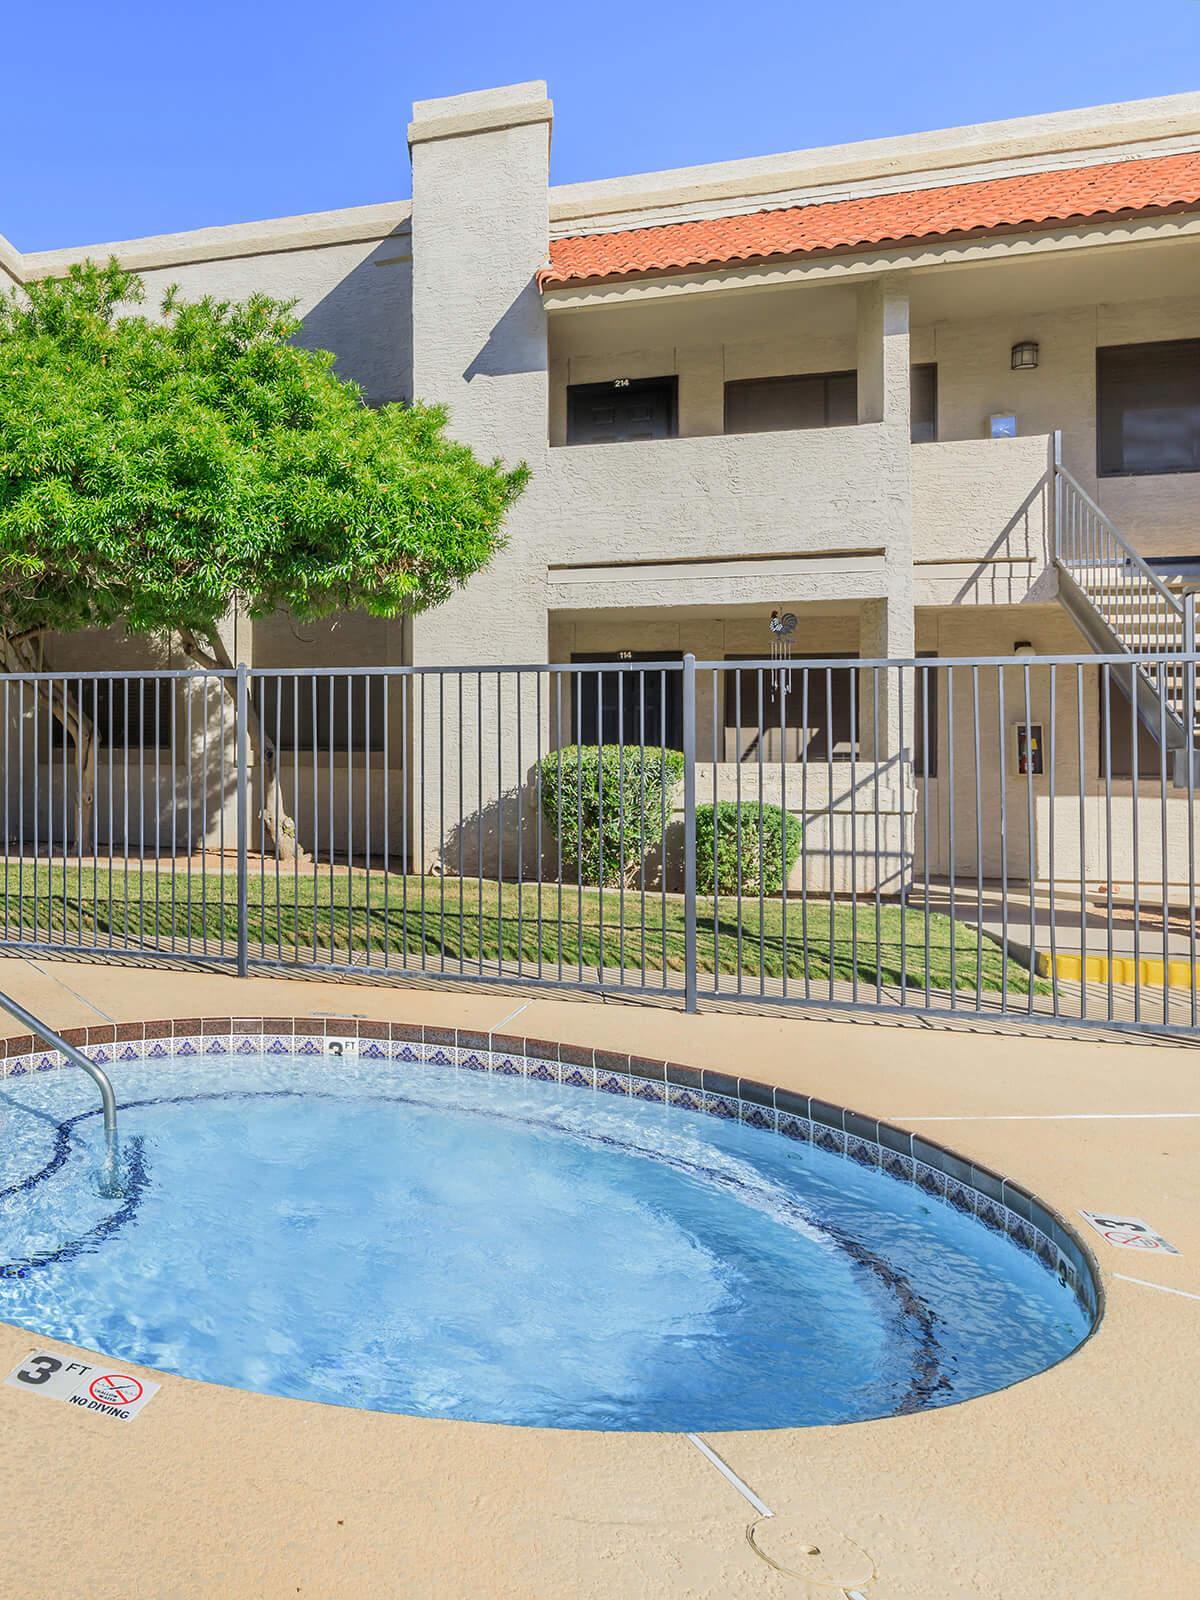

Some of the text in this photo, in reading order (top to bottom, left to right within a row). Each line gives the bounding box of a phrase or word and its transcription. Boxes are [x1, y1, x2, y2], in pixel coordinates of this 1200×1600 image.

[614, 379, 630, 387] 214
[345, 1041, 355, 1050] FT
[17, 1356, 92, 1385] 3 FT
[69, 1395, 130, 1420] NO DIVING
